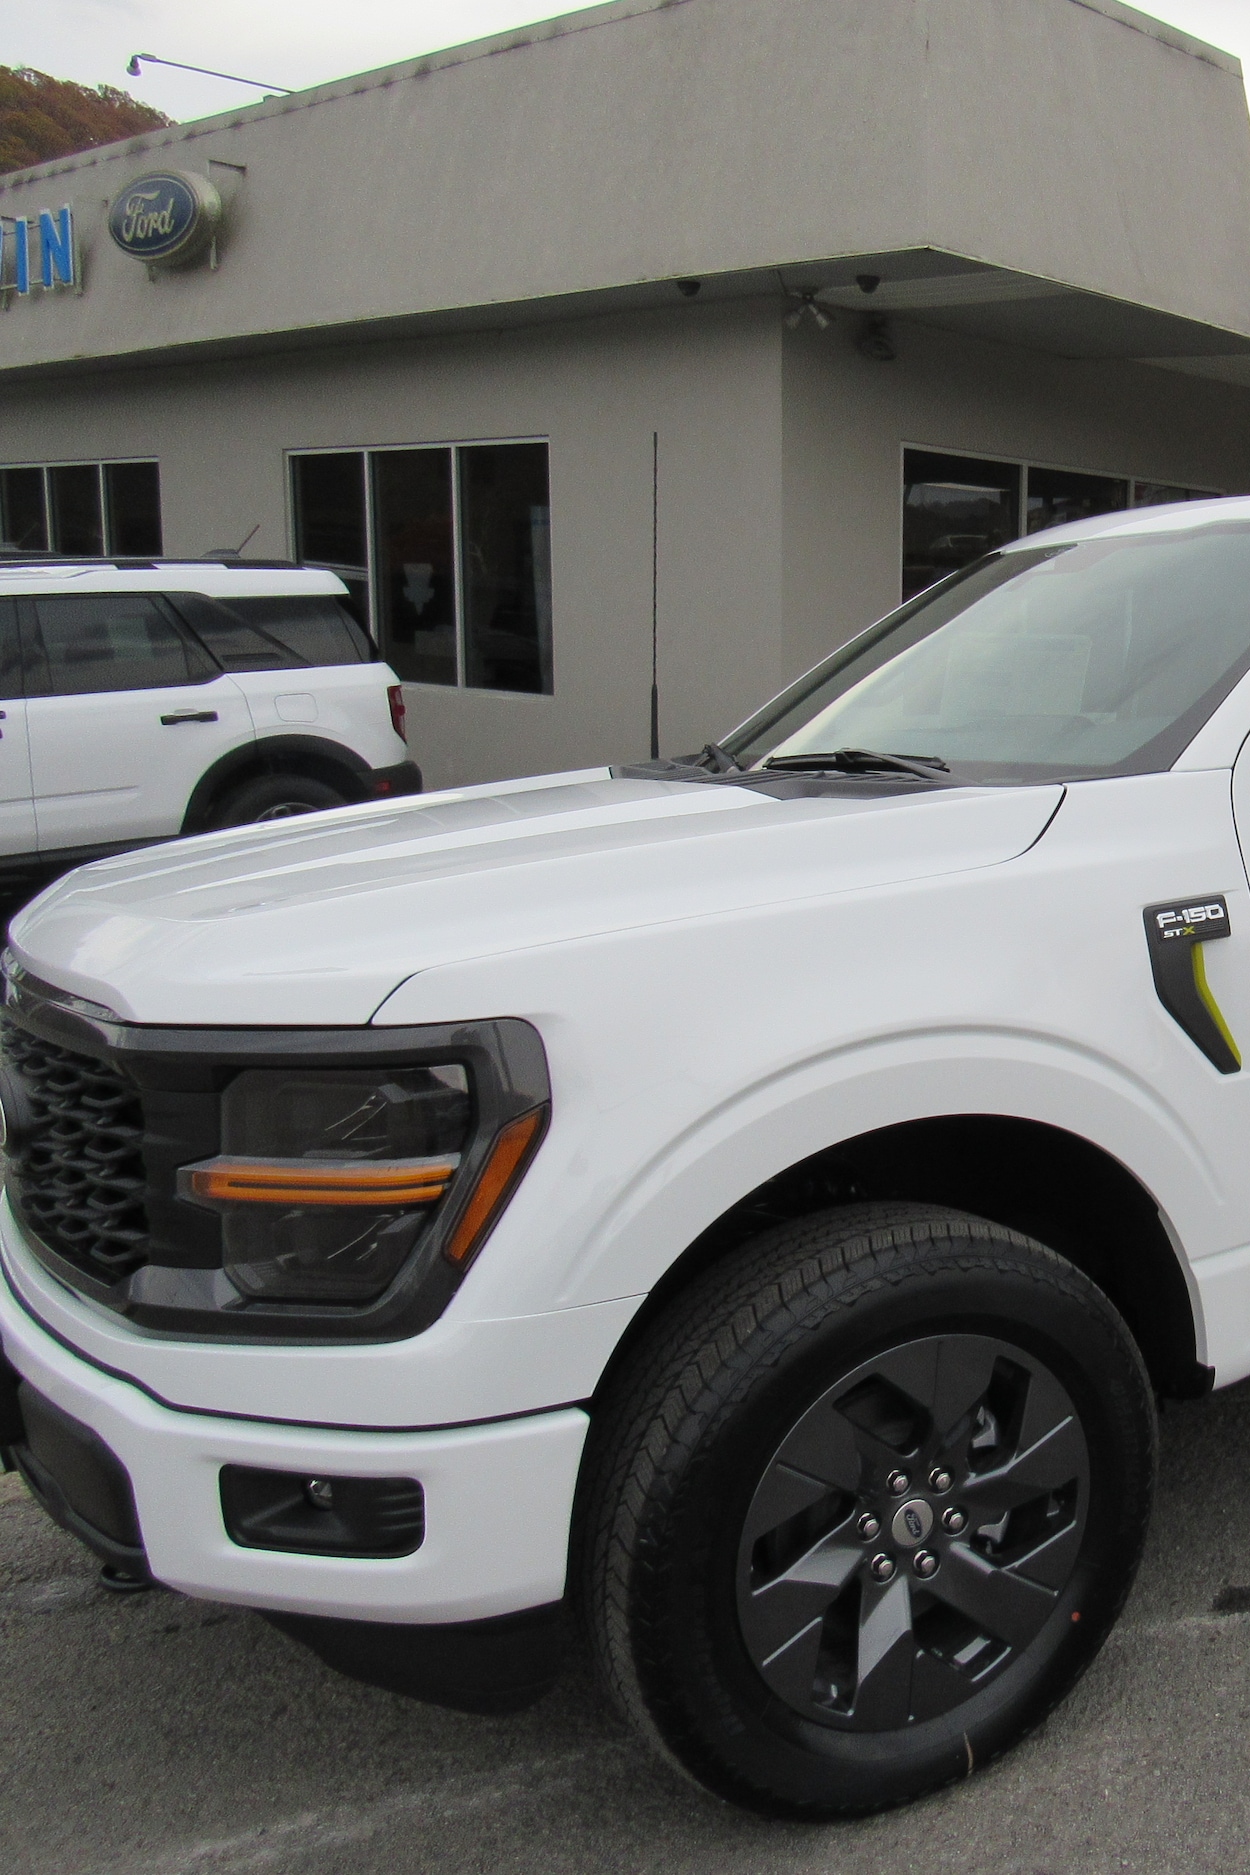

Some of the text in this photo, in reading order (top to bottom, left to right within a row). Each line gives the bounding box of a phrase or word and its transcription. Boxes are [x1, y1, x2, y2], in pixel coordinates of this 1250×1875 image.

[121, 189, 176, 243] Ford
[0, 203, 74, 297] IN
[1155, 903, 1225, 928] F-150
[1163, 925, 1196, 939] STX
